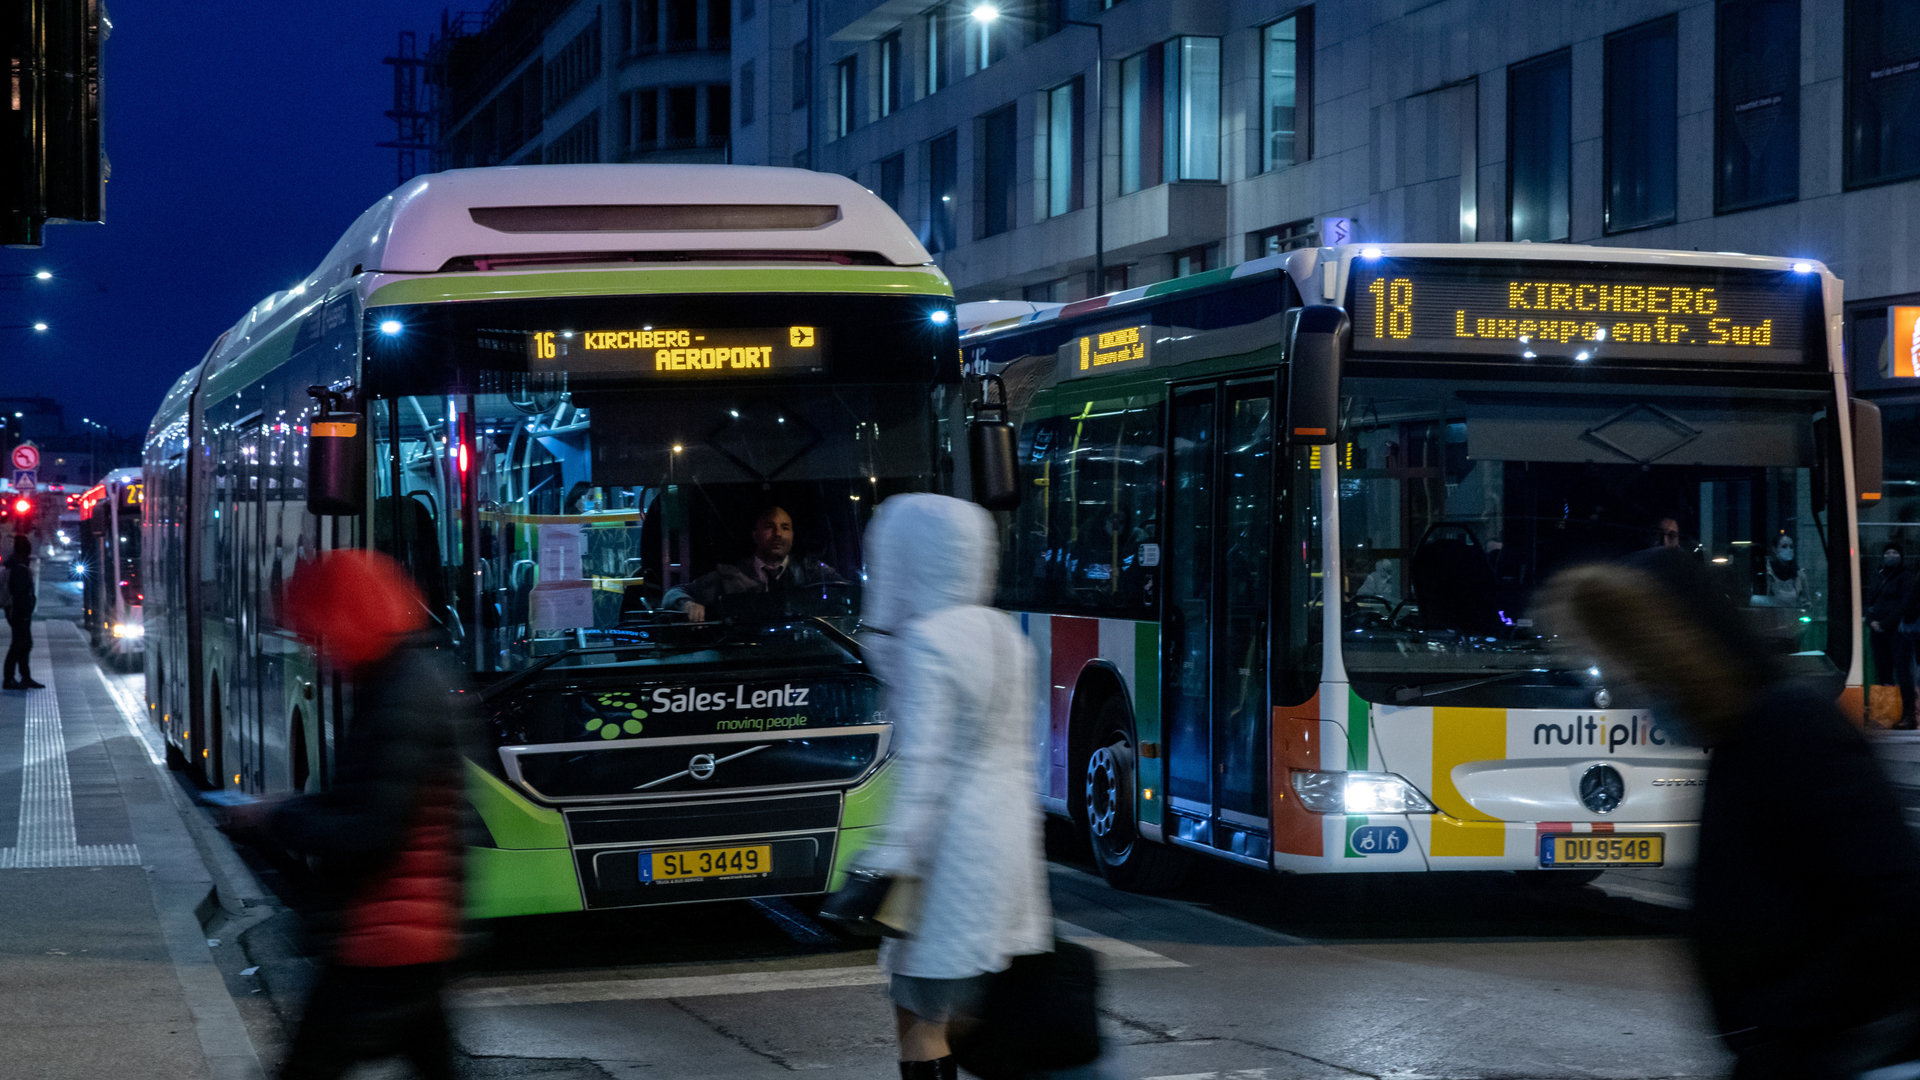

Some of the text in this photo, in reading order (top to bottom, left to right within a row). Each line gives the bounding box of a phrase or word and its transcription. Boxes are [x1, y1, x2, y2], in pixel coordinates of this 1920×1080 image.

[1370, 278, 1718, 339] 18 KIRCHBERG
[1455, 310, 1772, 346] Luxexpo entr. Sud
[534, 332, 556, 359] 16
[584, 330, 690, 350] KIRCHBERG
[655, 346, 773, 371] AEROPORT
[651, 683, 810, 714] Sales-Lentz
[716, 714, 808, 731] moving people
[1534, 715, 1711, 754] multiplic
[664, 854, 693, 875] SL
[699, 850, 758, 873] 3449
[1565, 840, 1591, 861] DU
[1596, 840, 1650, 860] 9548
